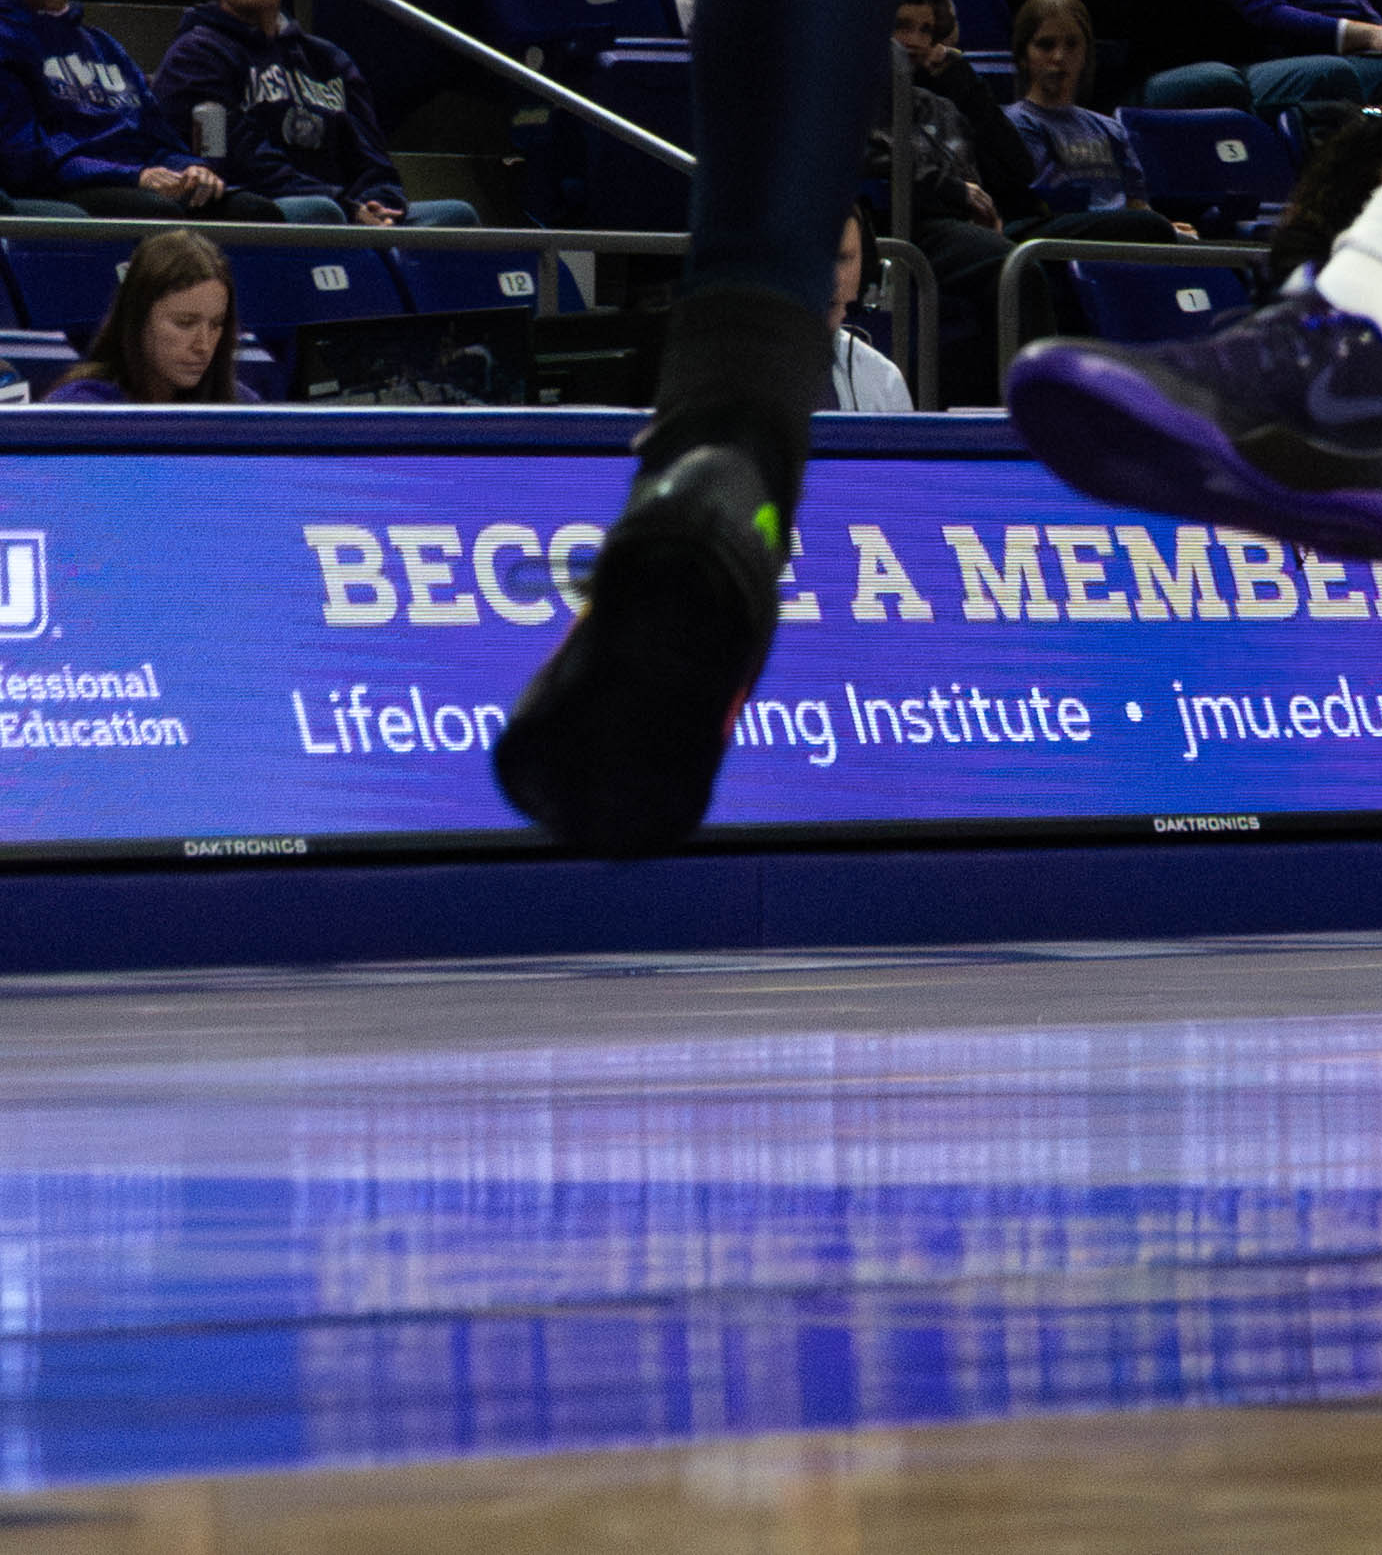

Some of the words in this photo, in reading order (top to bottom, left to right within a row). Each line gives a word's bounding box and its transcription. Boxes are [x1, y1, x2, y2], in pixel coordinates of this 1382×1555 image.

[320, 269, 341, 287] 11
[503, 273, 528, 293] 12
[849, 524, 934, 624] A
[292, 683, 508, 754] Lifelon
[846, 681, 1093, 745] Institute
[1153, 815, 1261, 833] DAKTRONICS
[184, 838, 308, 856] DAKTRONICS
